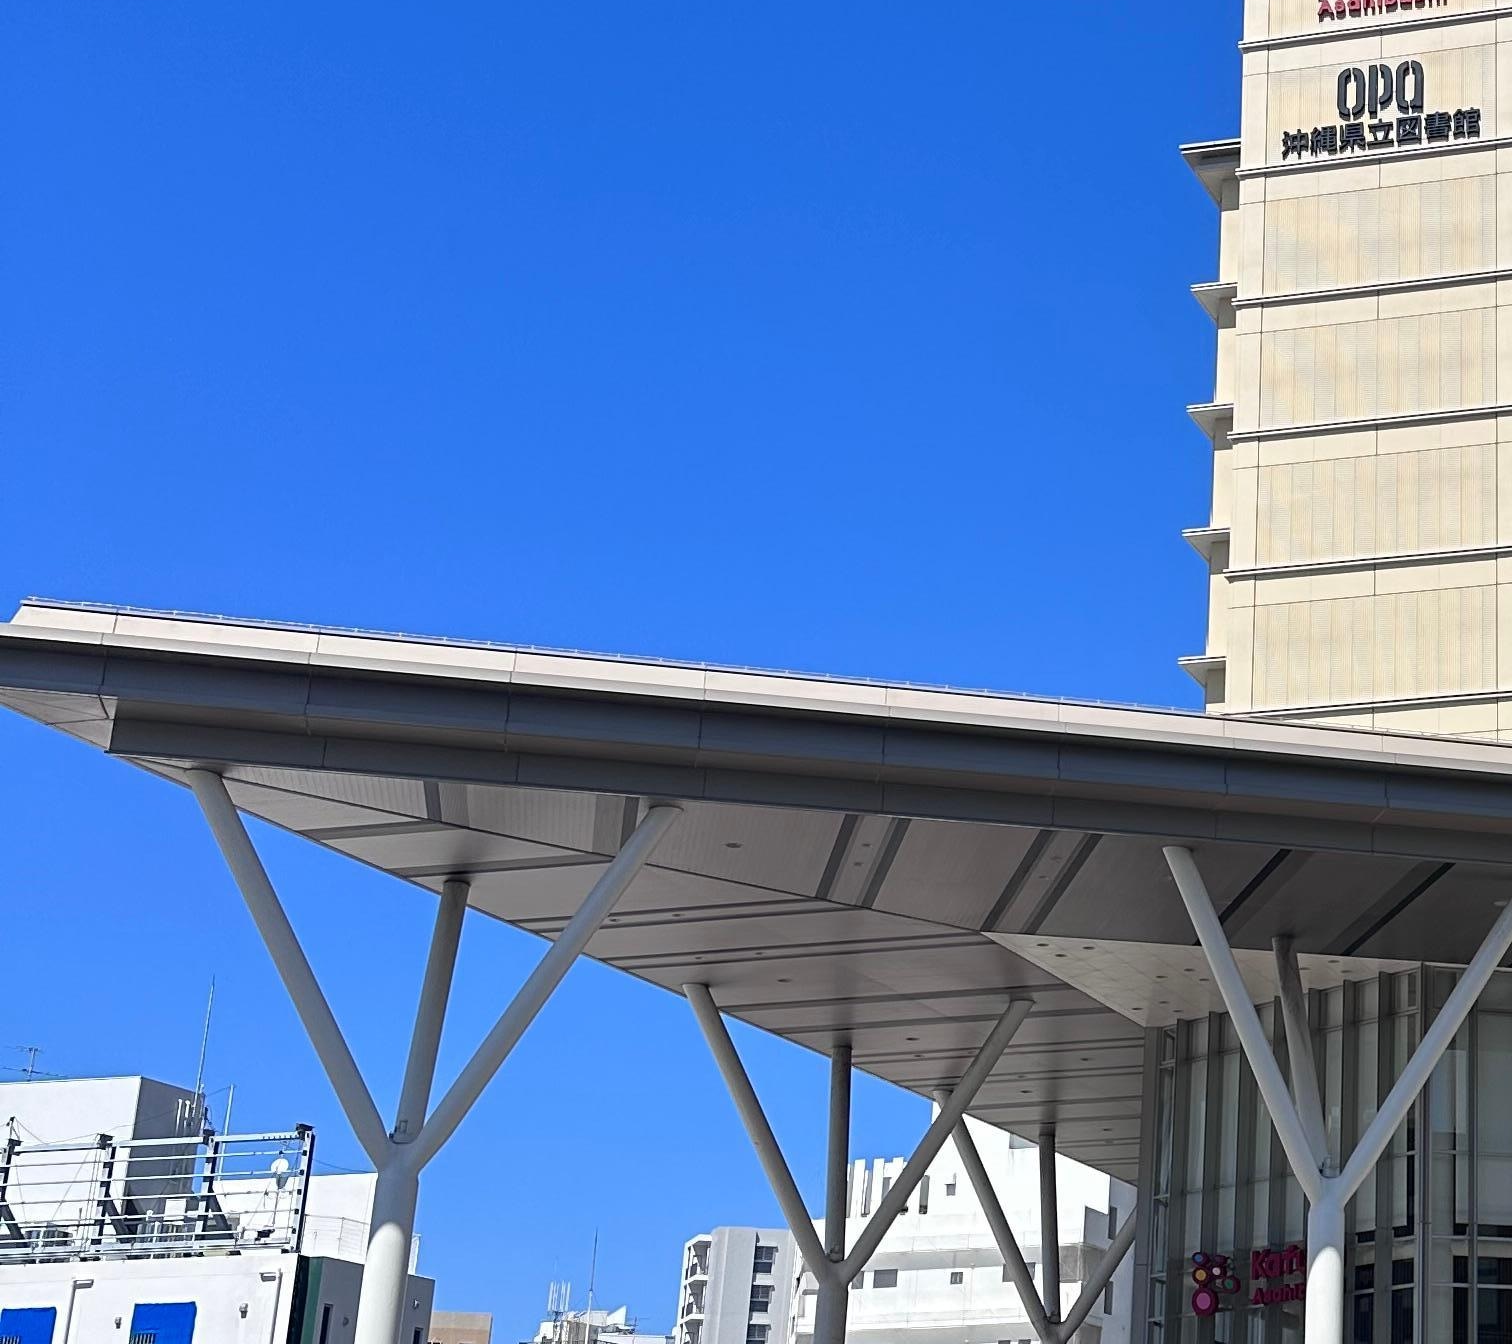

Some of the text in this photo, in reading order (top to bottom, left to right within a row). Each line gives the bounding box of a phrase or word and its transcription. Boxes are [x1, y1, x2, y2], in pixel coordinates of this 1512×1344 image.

[1282, 108, 1481, 158] 沖縄県立図書館
